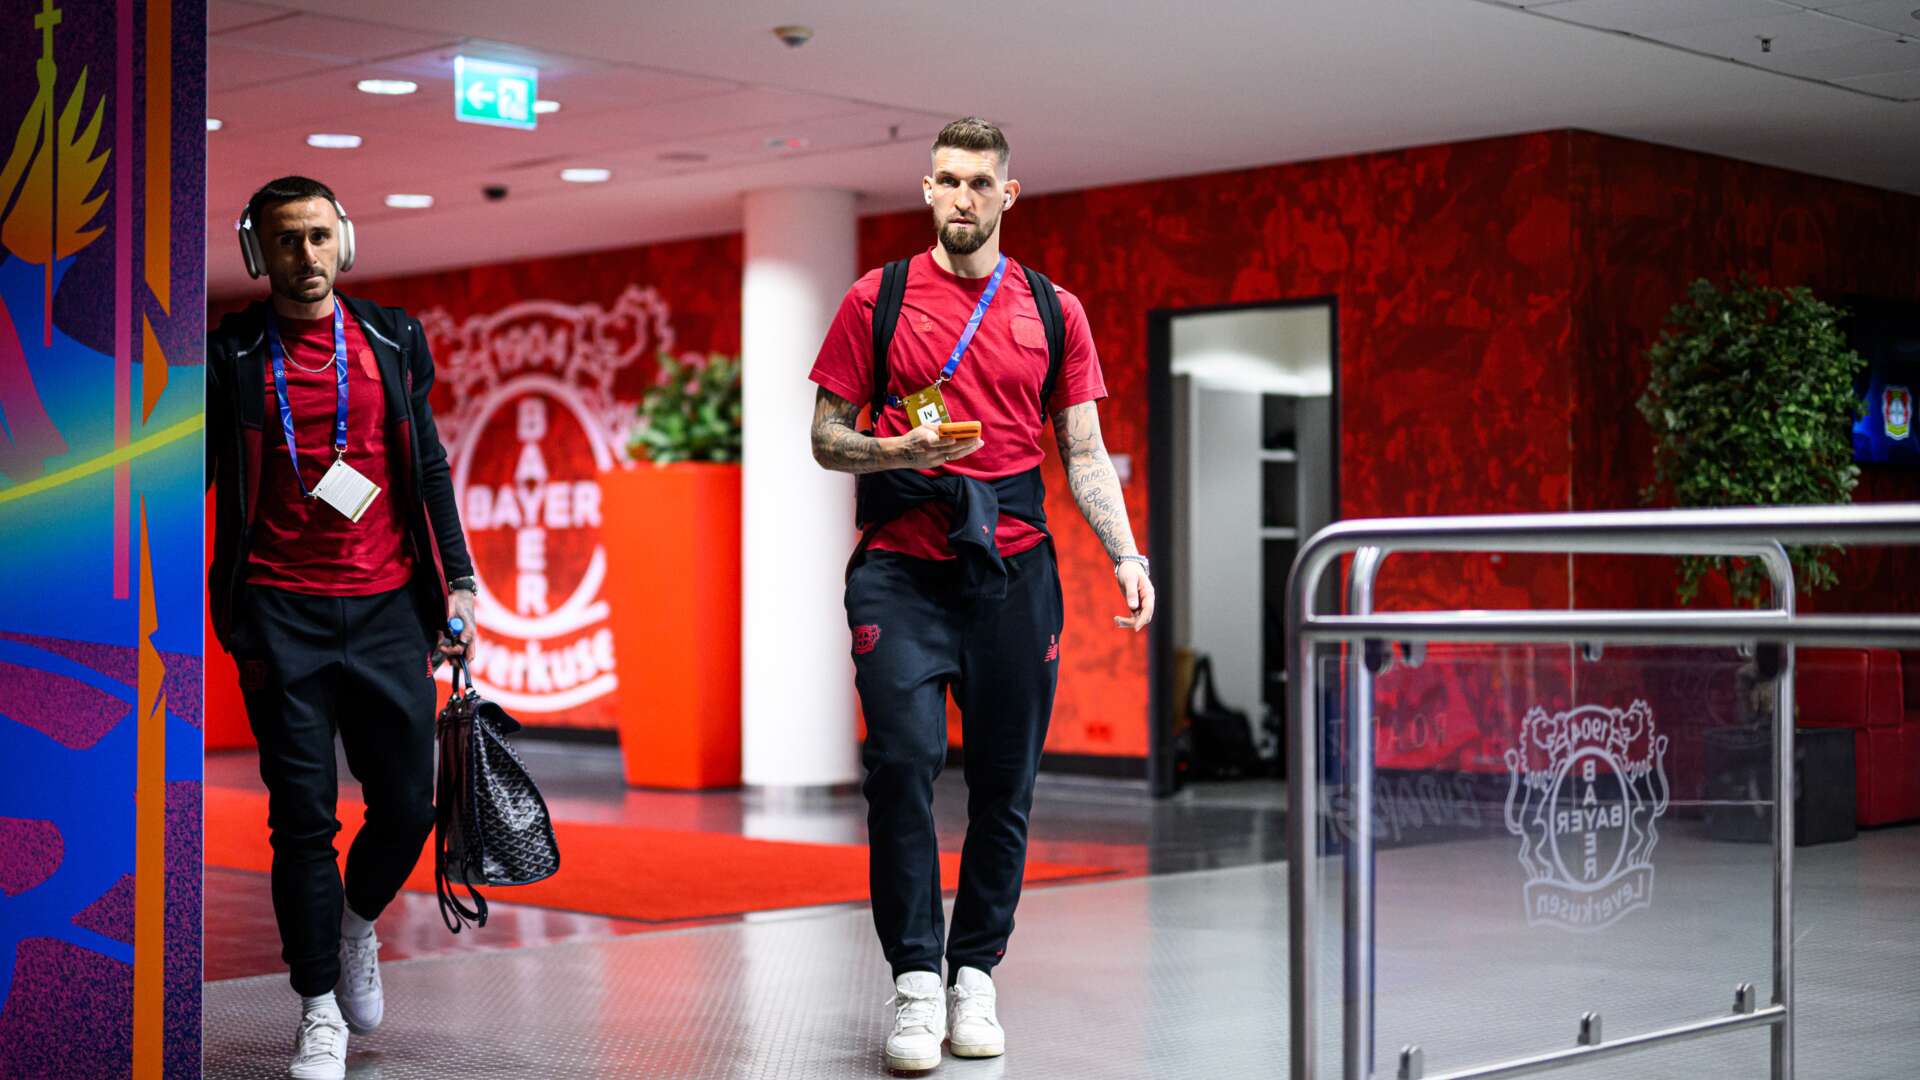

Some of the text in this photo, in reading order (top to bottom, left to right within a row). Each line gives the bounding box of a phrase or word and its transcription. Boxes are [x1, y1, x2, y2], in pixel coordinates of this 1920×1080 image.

[466, 480, 602, 530] BAYER
[515, 398, 549, 615] BAYER
[470, 627, 617, 693] verkuse
